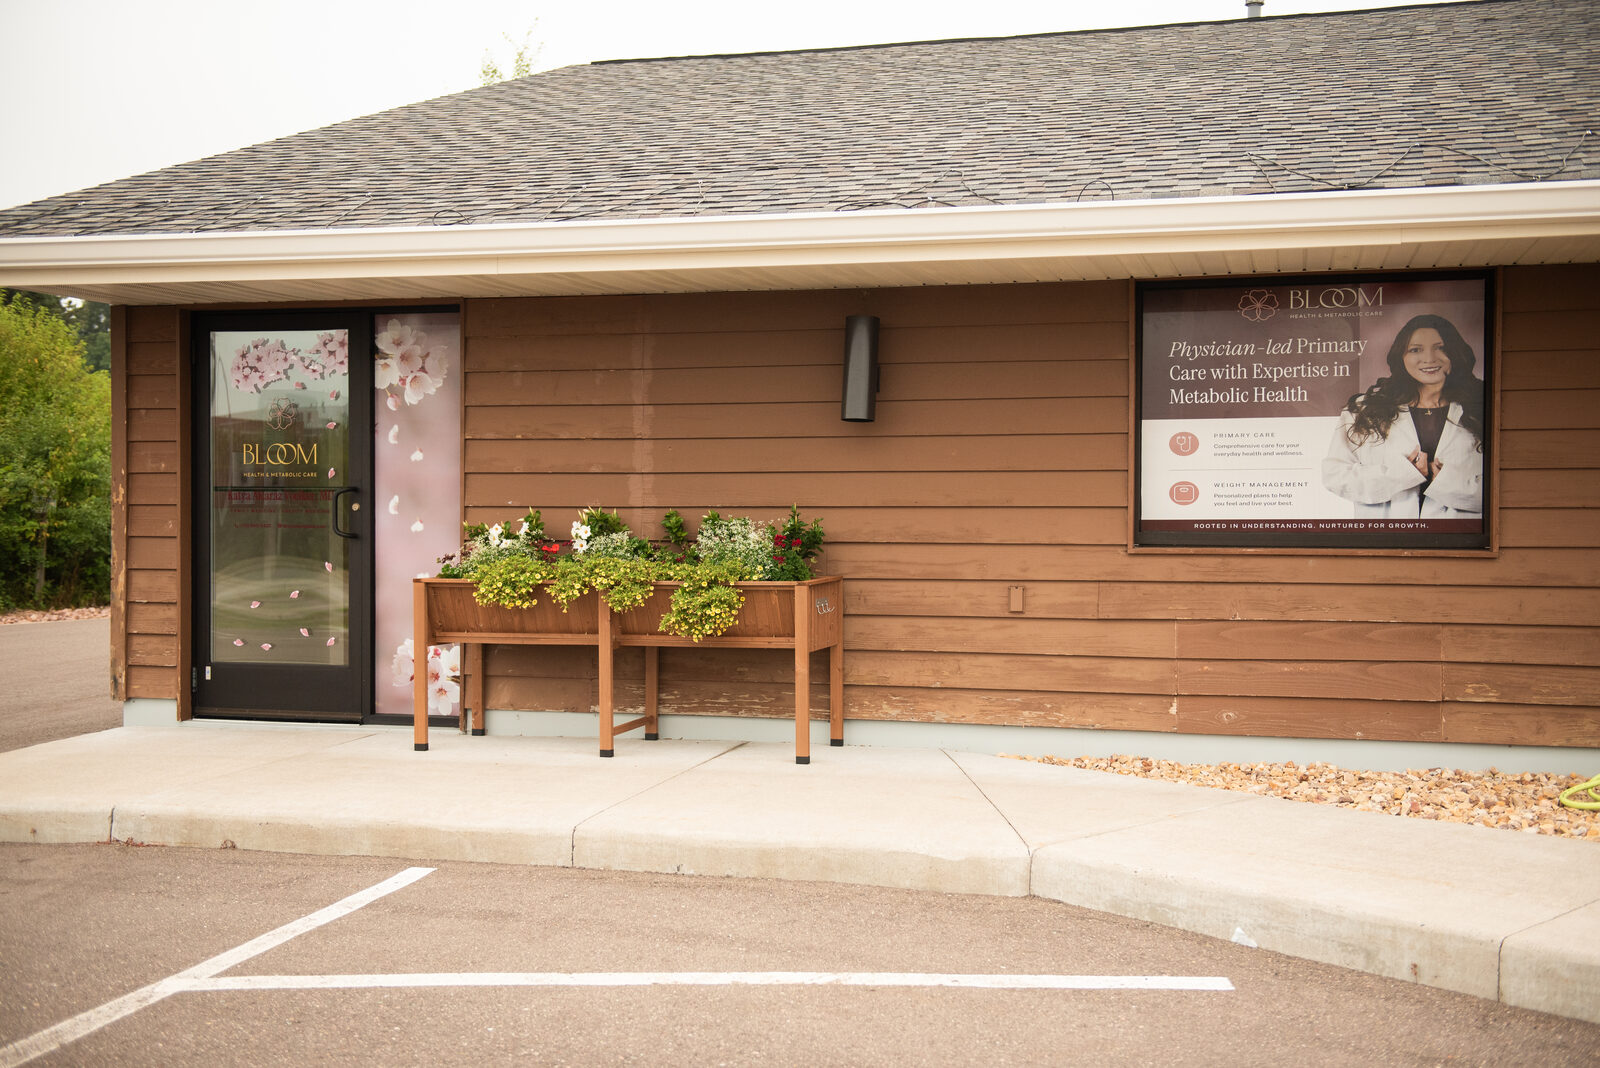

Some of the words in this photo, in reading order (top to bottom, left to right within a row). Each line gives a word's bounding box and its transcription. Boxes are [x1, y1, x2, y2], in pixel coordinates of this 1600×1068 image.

[1290, 287, 1383, 309] BLOOM
[1297, 337, 1368, 356] Primary
[1169, 365, 1206, 381] Care
[1210, 363, 1248, 380] with
[1252, 362, 1329, 382] Expertise
[1333, 361, 1351, 377] in
[1169, 387, 1249, 405] Metabolic
[1253, 386, 1309, 403] Health
[243, 443, 317, 465] BLOOM
